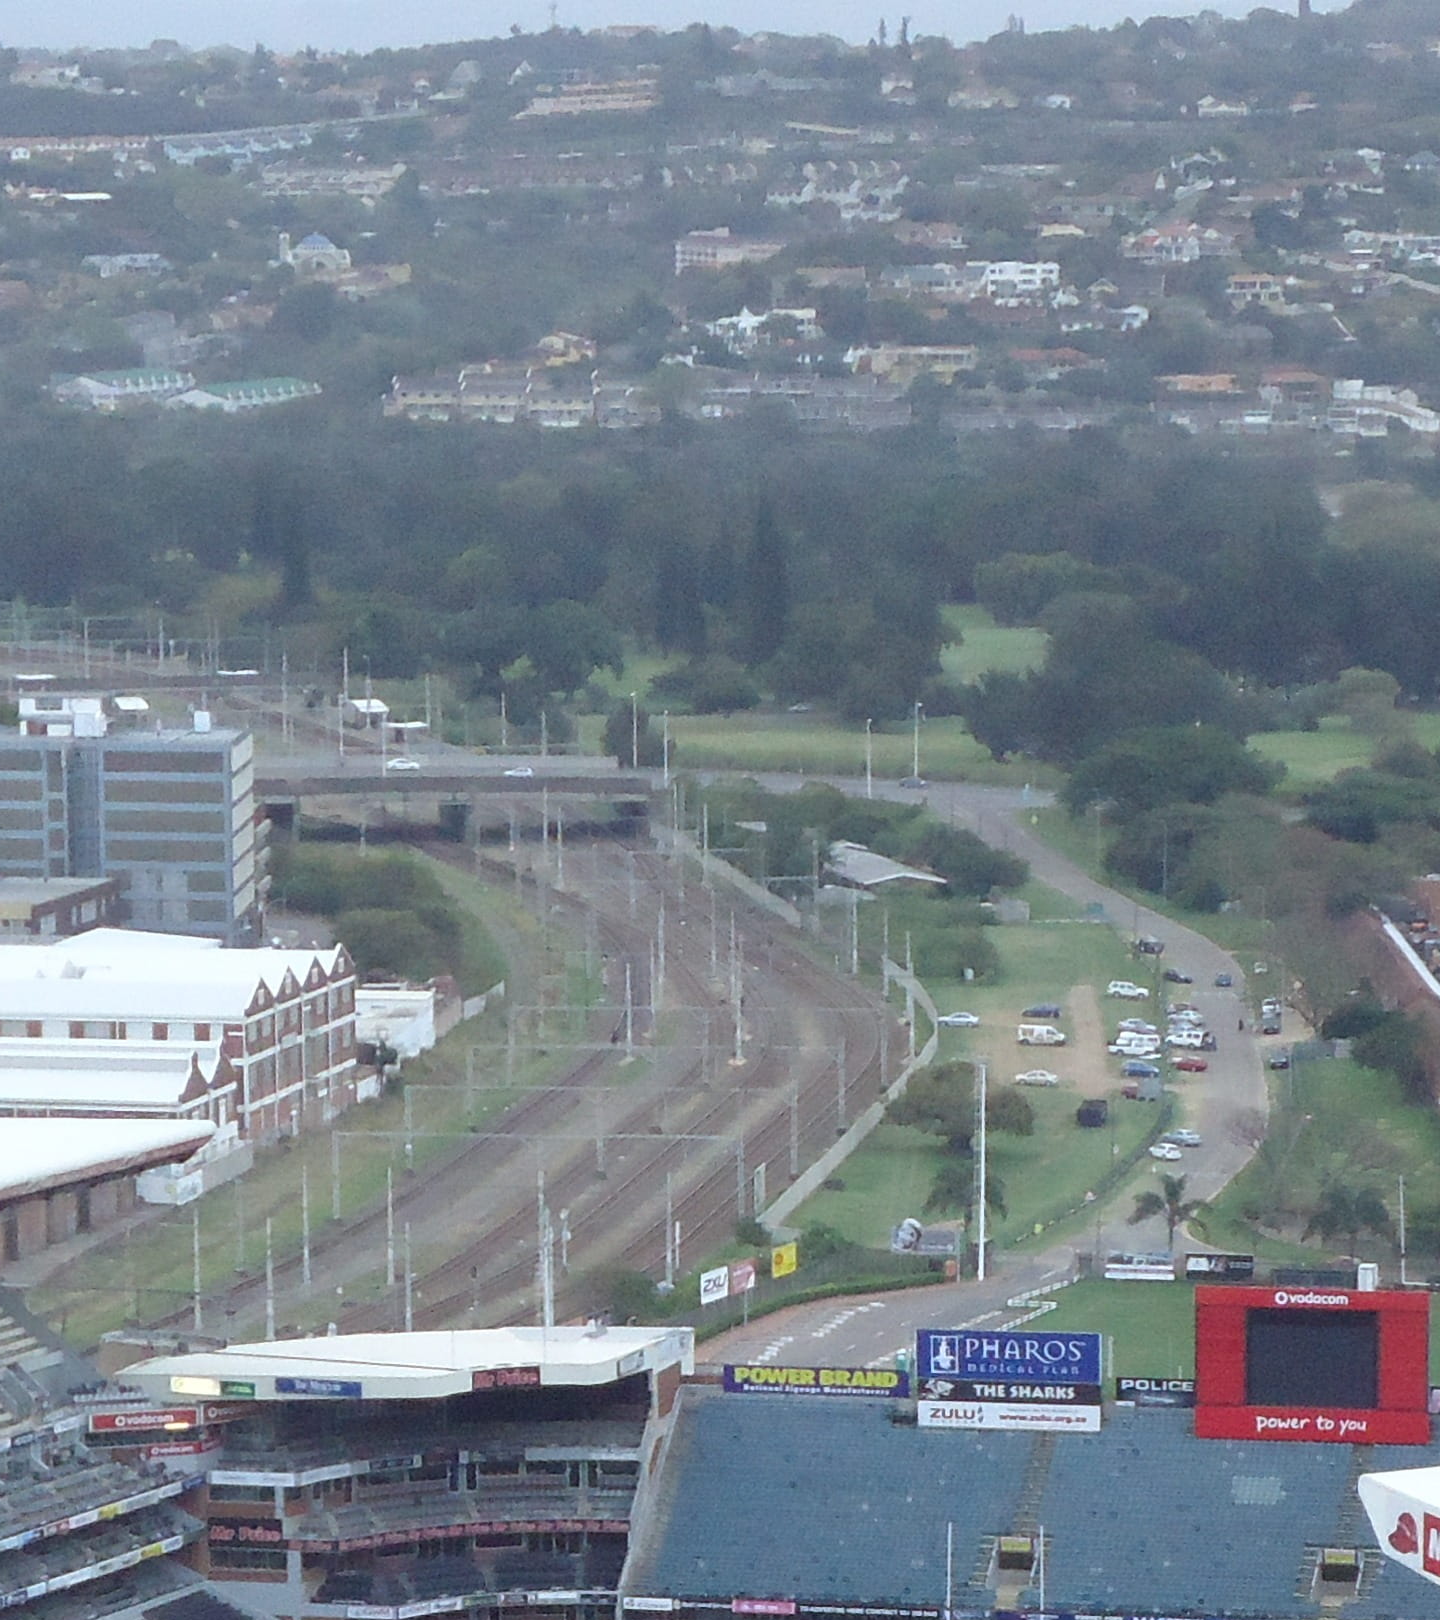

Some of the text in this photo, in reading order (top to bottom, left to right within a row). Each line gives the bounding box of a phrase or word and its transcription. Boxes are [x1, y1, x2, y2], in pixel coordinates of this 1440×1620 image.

[1288, 1291, 1349, 1305] vodacom
[965, 1337, 1082, 1364] PHAROS
[967, 1362, 1035, 1374] MEDICAL
[734, 1367, 899, 1389] POWER BRAND
[973, 1384, 1076, 1399] THE SHARKS
[1121, 1379, 1194, 1392] POLICE
[127, 1413, 175, 1426] vodacom
[929, 1408, 976, 1420] ZULU
[1256, 1415, 1367, 1436] power to you
